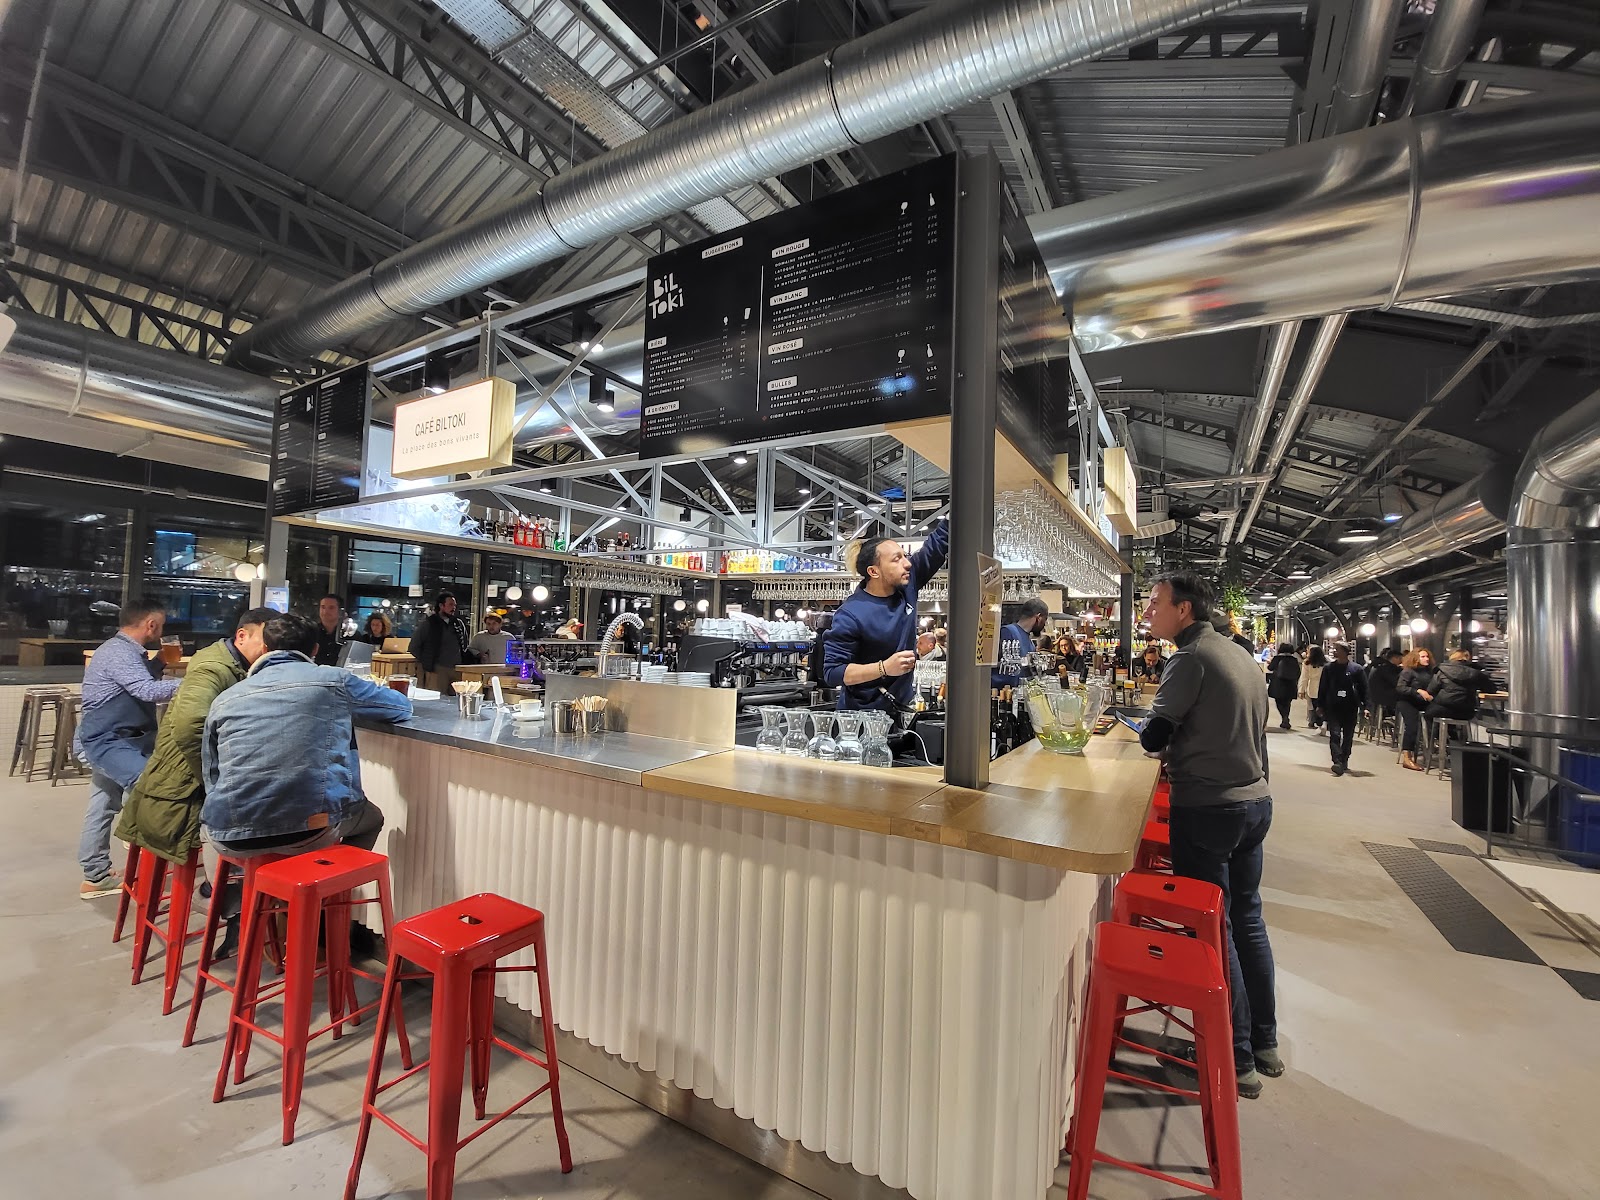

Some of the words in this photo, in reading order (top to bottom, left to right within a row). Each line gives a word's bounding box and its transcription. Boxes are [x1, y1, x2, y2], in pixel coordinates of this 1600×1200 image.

[705, 242, 739, 257] SUGGESTIONS
[786, 243, 804, 252] ROUGE
[784, 292, 803, 301] BLANC
[783, 341, 797, 350] ROSÉ
[771, 380, 792, 389] BULLES
[415, 416, 434, 436] CAFÉ
[436, 412, 466, 432] BILTOKI
[410, 444, 425, 454] place
[440, 438, 454, 447] bons
[456, 432, 480, 442] vivants
